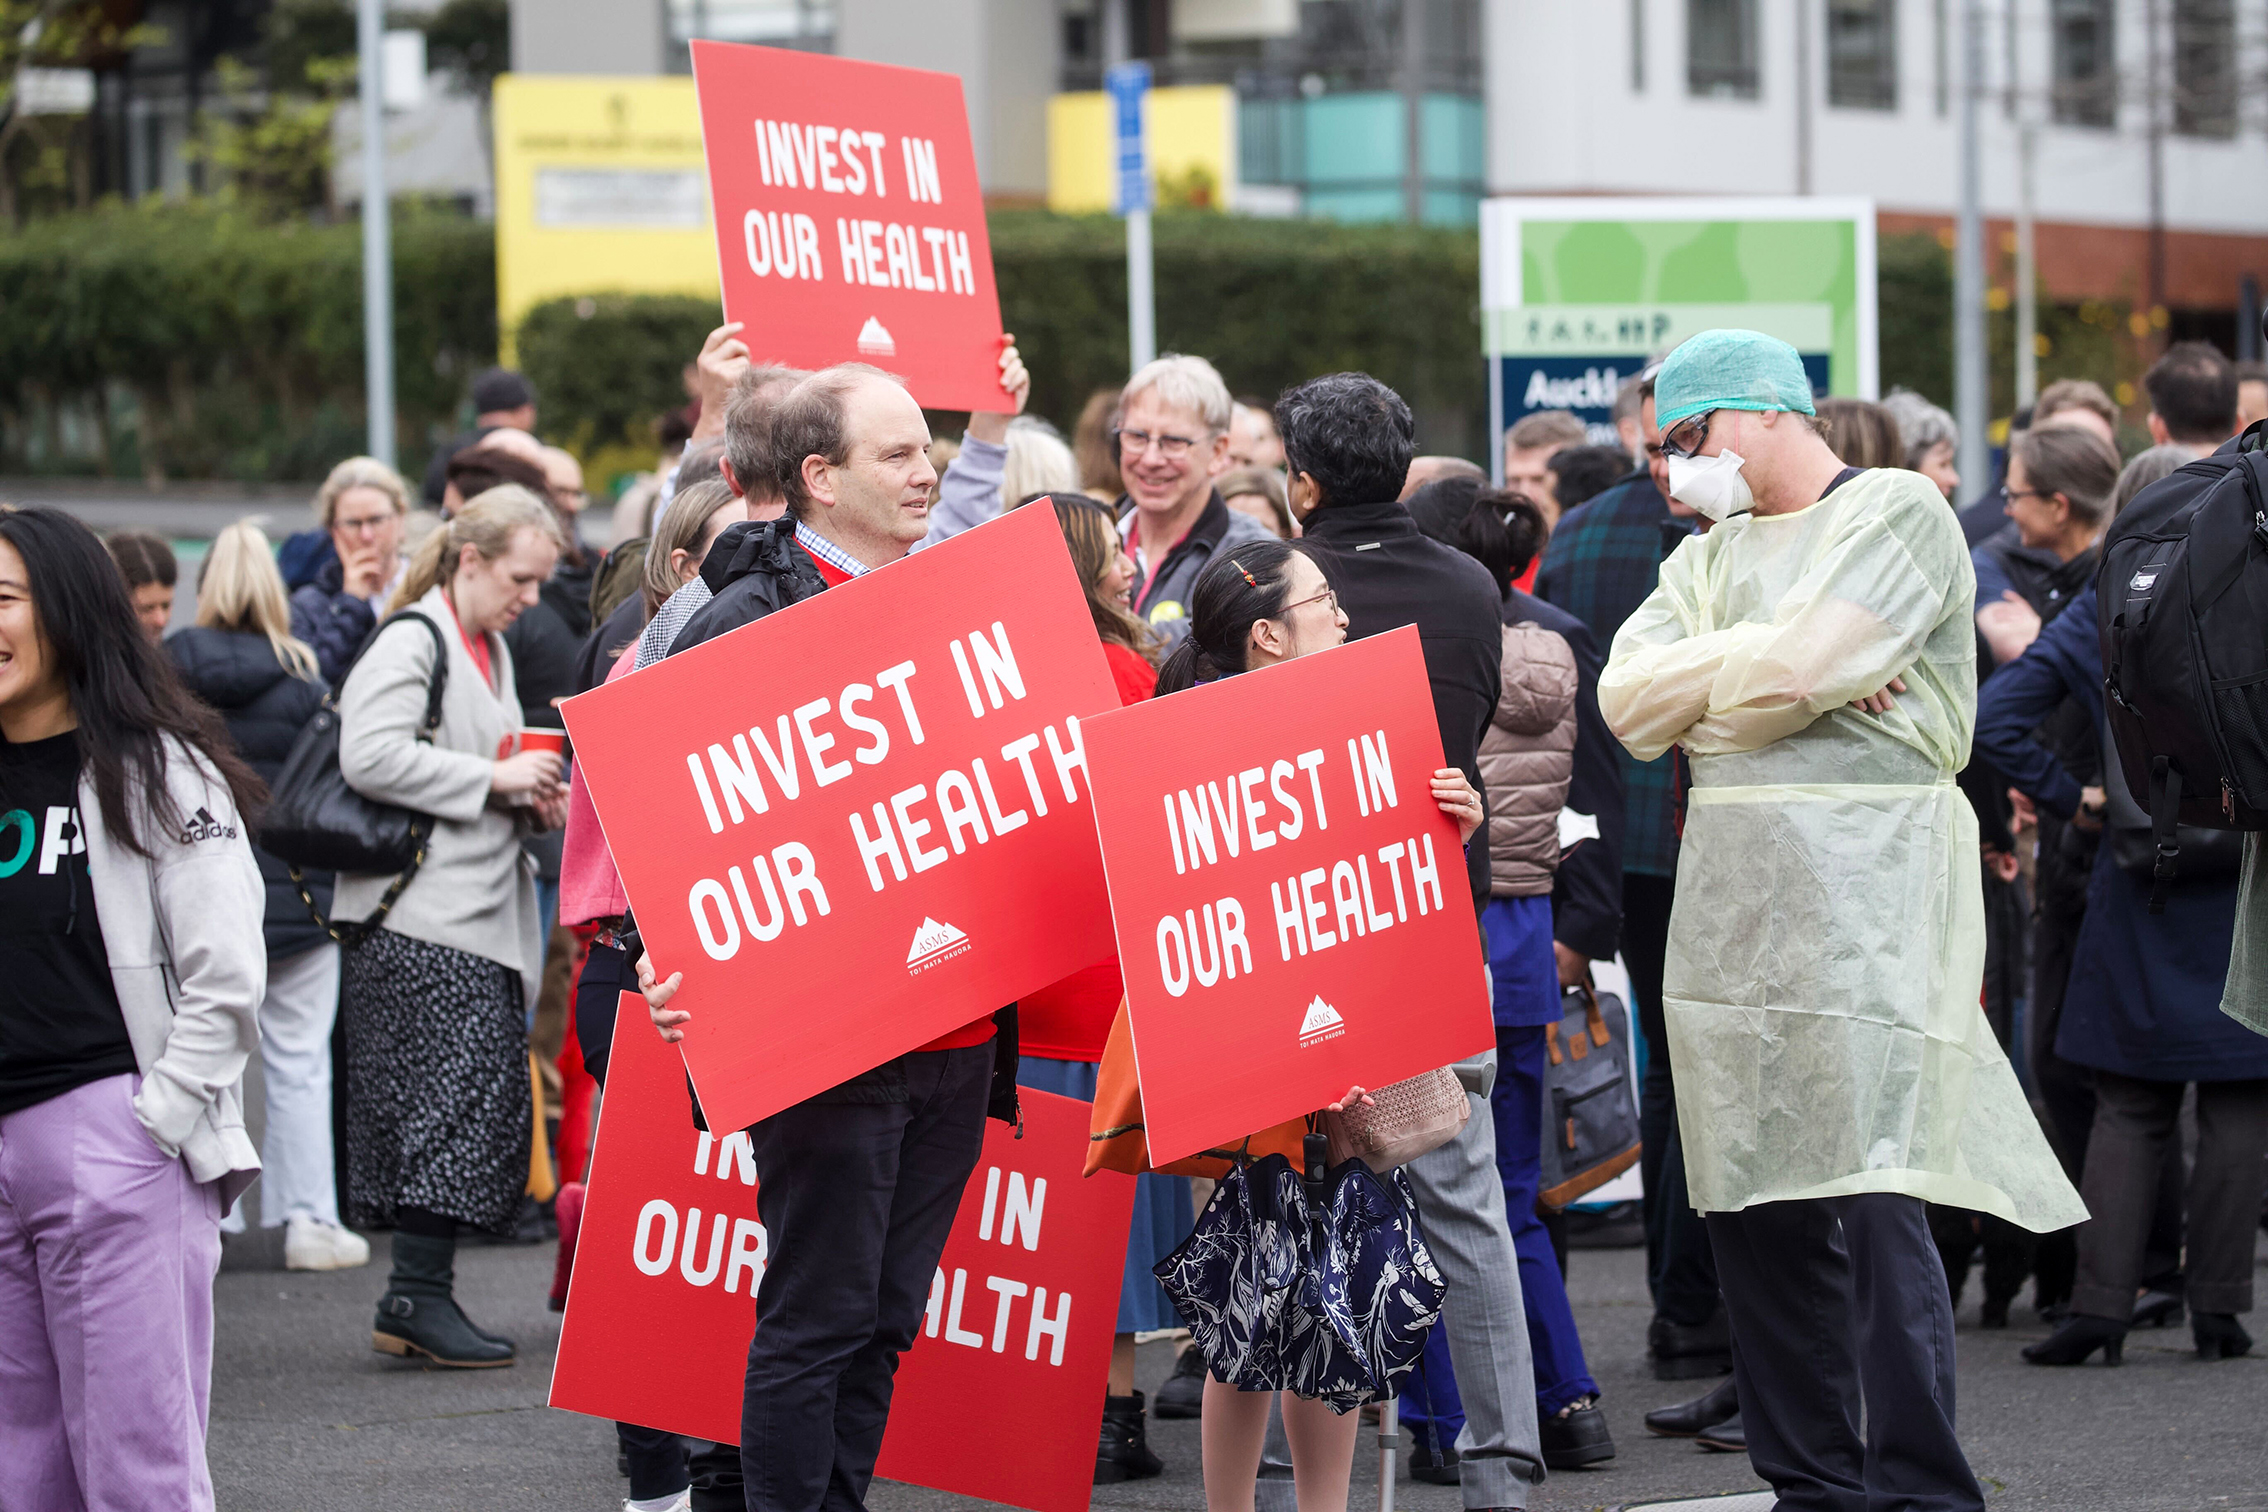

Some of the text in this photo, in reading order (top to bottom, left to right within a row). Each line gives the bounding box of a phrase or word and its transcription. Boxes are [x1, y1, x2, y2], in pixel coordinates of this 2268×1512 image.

[754, 118, 887, 198] INVEST
[900, 136, 943, 205] IN
[743, 208, 976, 297] OUR HEALTH
[1524, 367, 1620, 410] Auckl
[686, 620, 1027, 835] INVEST IN
[688, 714, 1091, 961] OUR HEALTH
[1163, 729, 1398, 875] INVEST IN
[918, 930, 949, 954] ASMS
[1156, 832, 1444, 998] OUR HEALTH
[909, 944, 972, 977] TOI MATA HAUORA
[1300, 1041, 1309, 1049] TOI
[1310, 1036, 1323, 1046] MATA
[1309, 1011, 1331, 1029] ASMS
[978, 1166, 1047, 1252] IN
[633, 1199, 1072, 1368] OUR ALTH
